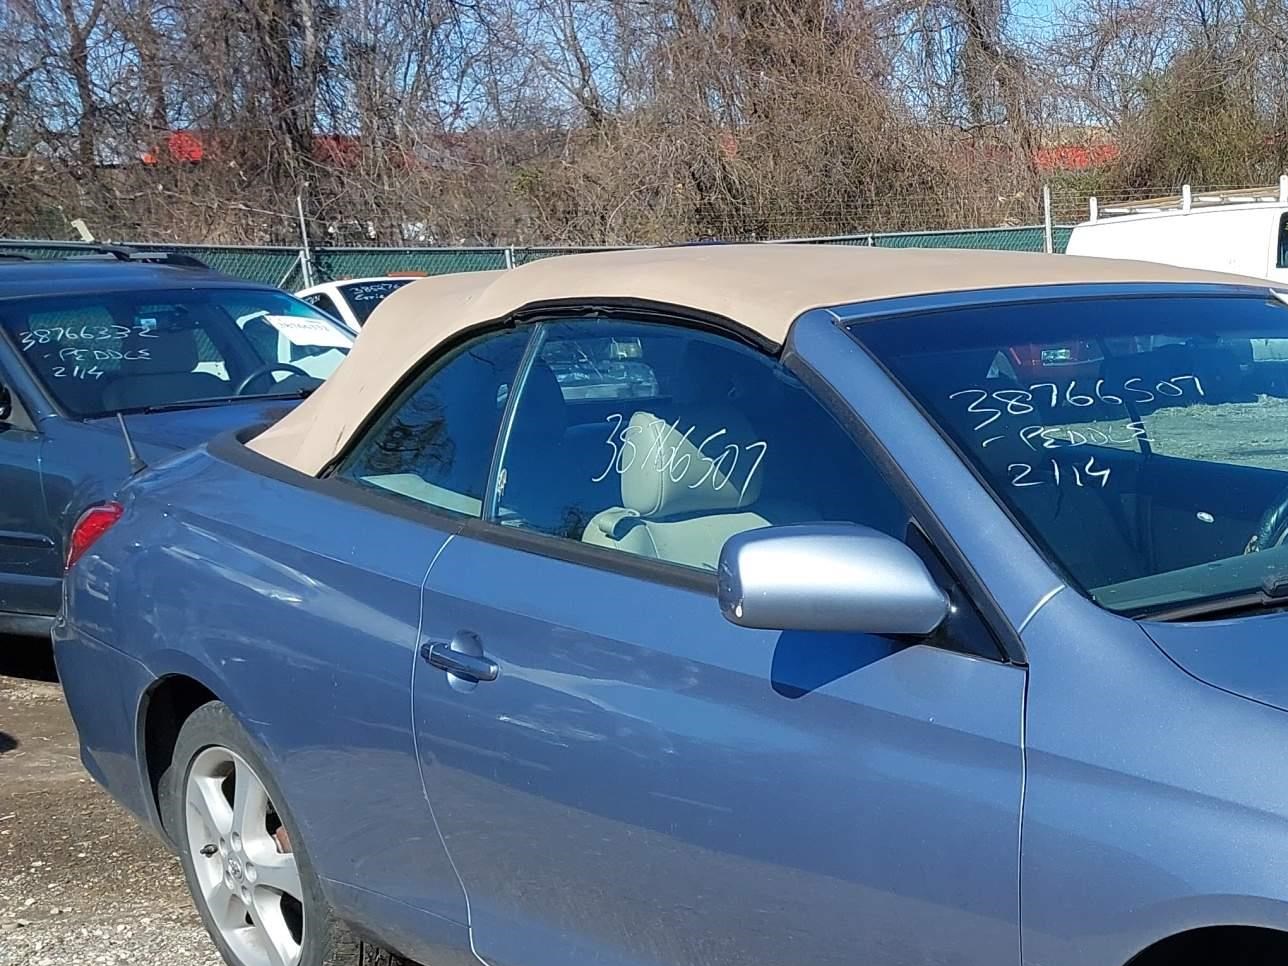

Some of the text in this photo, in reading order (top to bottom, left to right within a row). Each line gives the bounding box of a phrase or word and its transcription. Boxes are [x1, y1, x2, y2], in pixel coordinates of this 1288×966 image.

[19, 324, 160, 351] 38766332
[949, 375, 1205, 430] 38766507
[1019, 422, 1155, 451] PEDDLE
